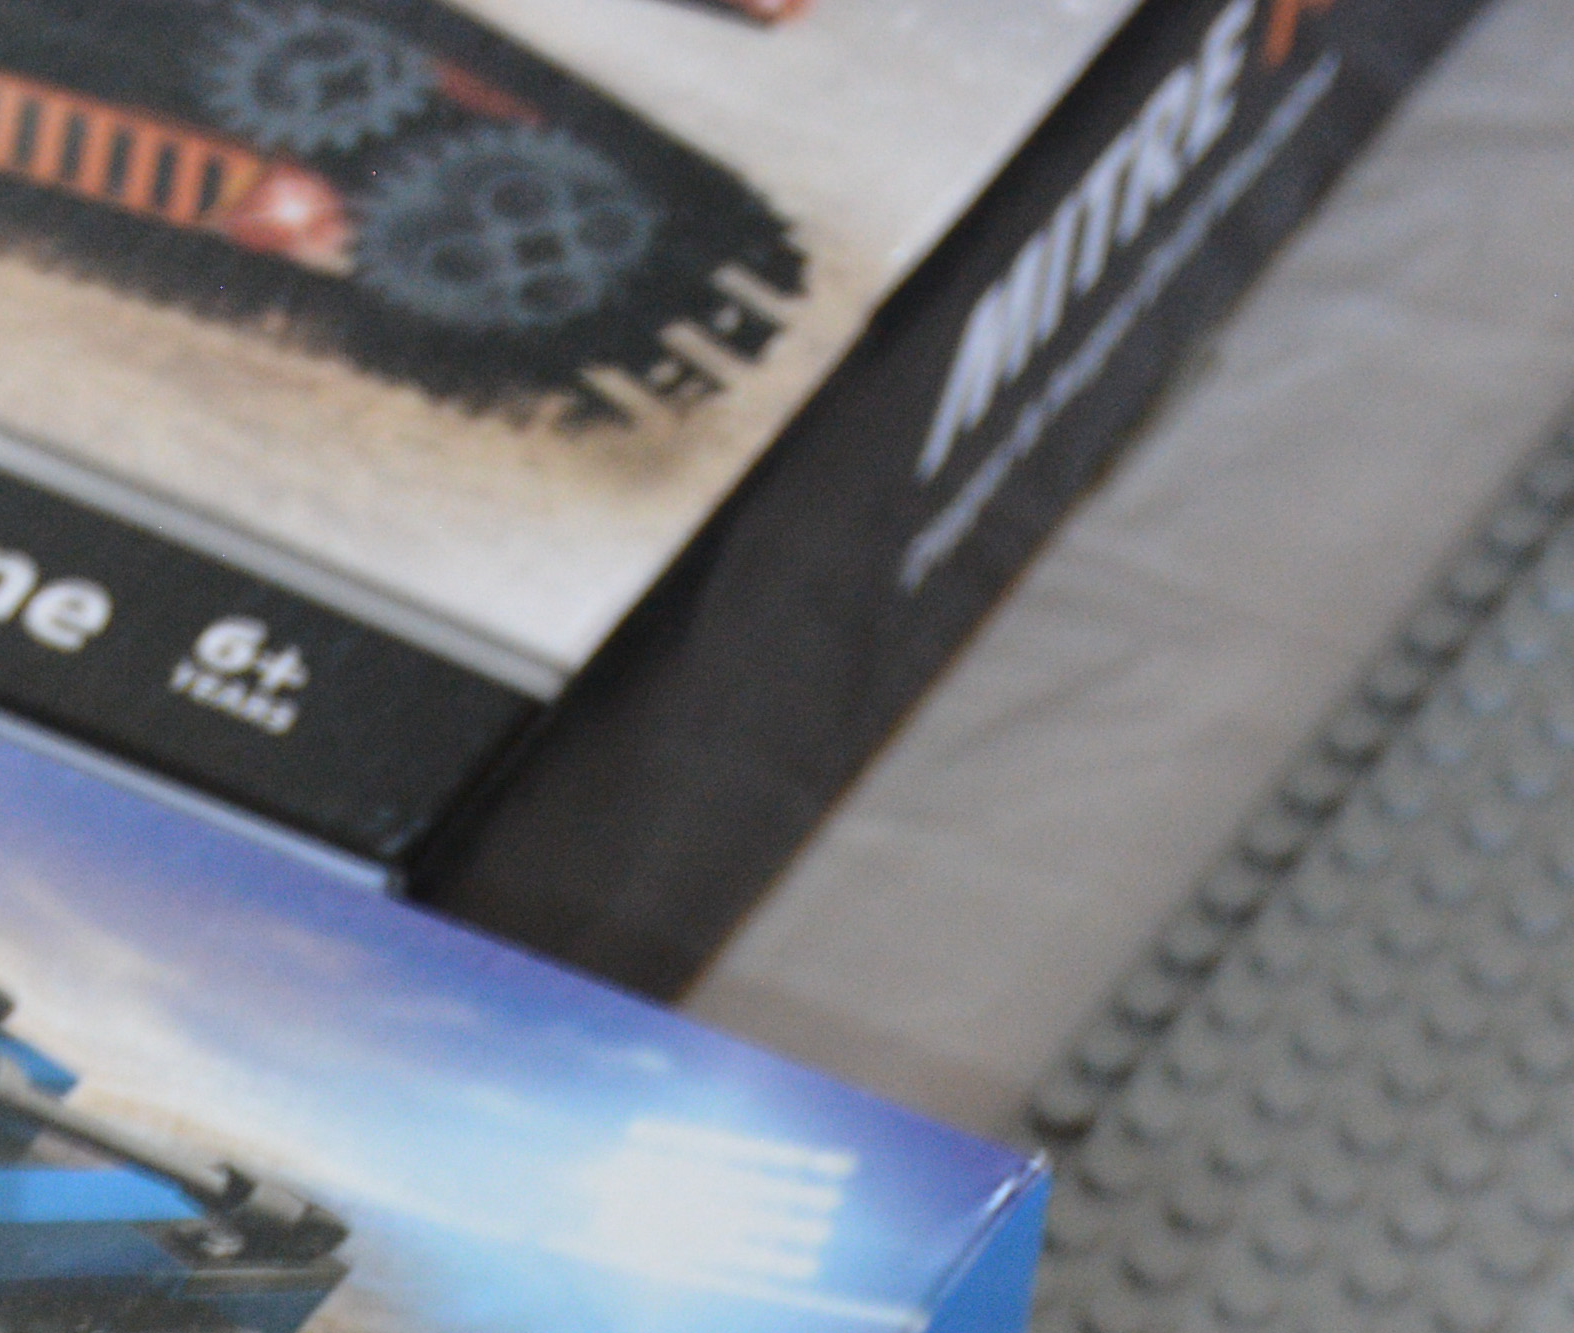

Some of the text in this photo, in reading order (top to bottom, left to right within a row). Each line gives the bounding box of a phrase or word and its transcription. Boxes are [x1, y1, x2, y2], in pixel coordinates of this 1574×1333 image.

[916, 0, 1254, 482] MITRE
[169, 660, 300, 736] YEARS
[190, 616, 312, 698] 6+
